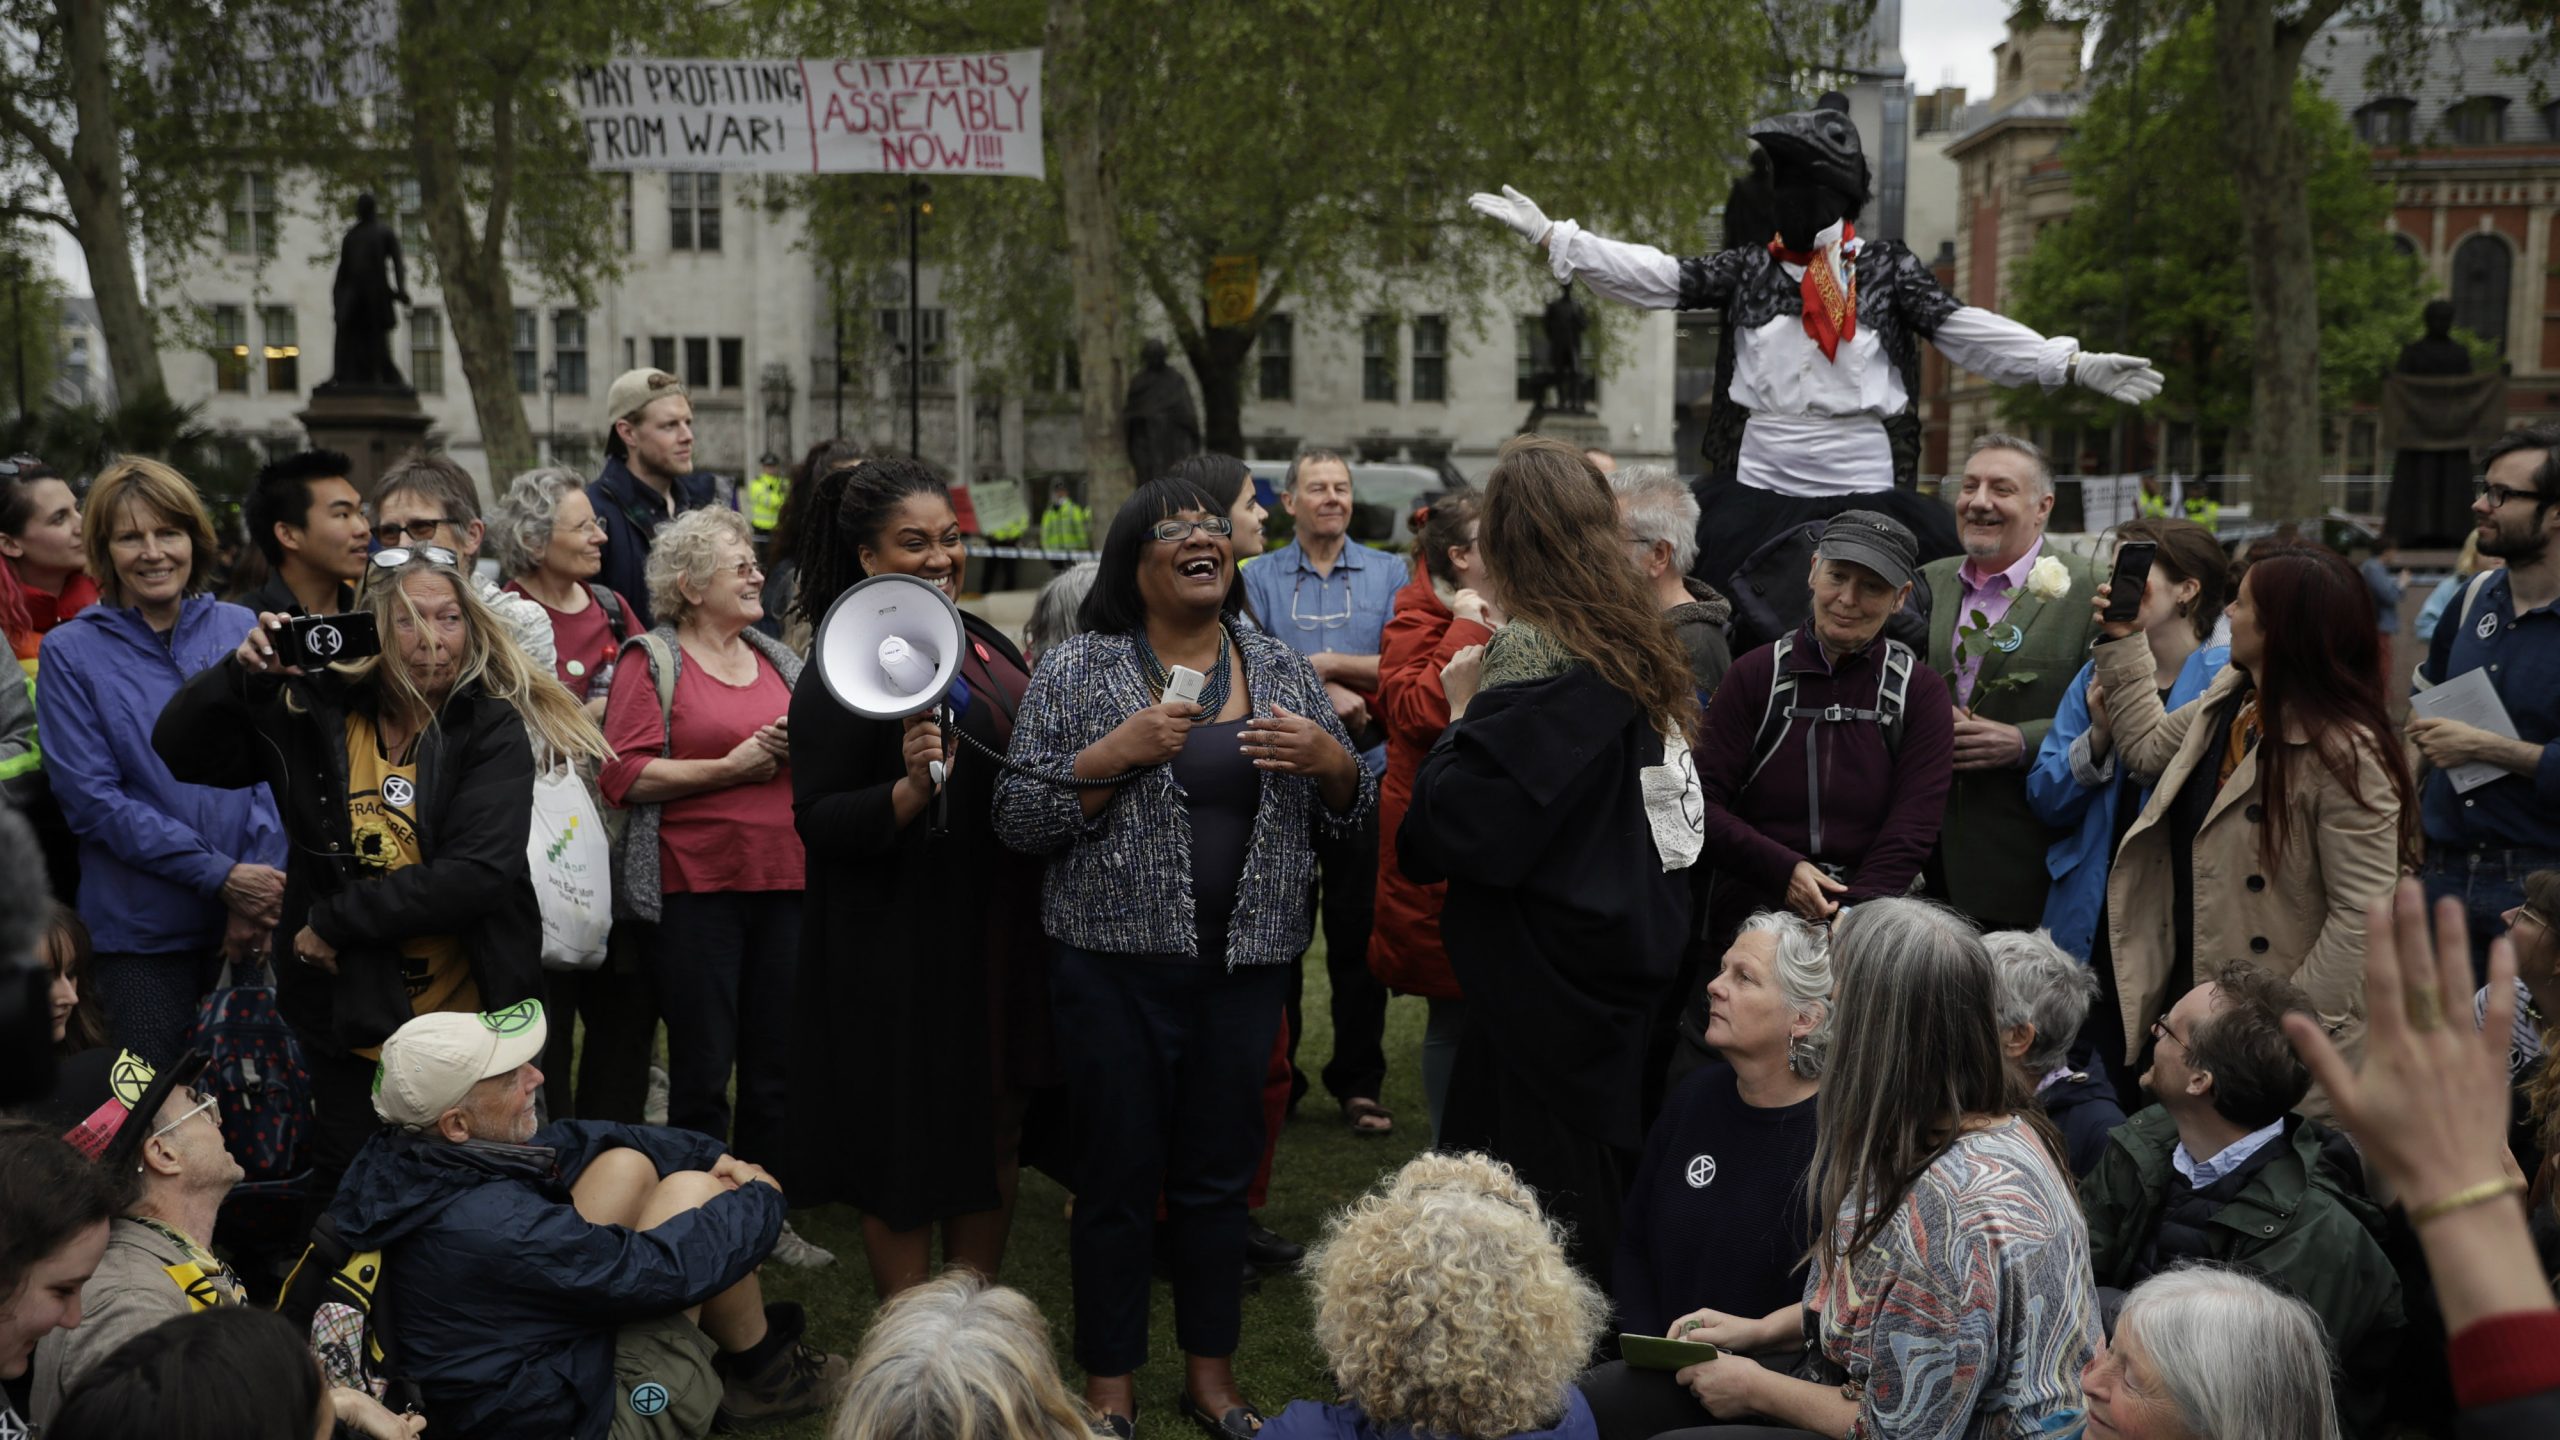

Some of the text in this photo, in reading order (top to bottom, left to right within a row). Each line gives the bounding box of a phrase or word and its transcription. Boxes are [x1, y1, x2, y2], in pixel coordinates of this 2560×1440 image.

[574, 64, 801, 107] MAY PROFITING
[833, 55, 1009, 89] CITIZENS
[823, 84, 1029, 133] ASSEMBLY
[585, 112, 785, 160] FROM WAR!
[882, 133, 1005, 172] NOW!!!!
